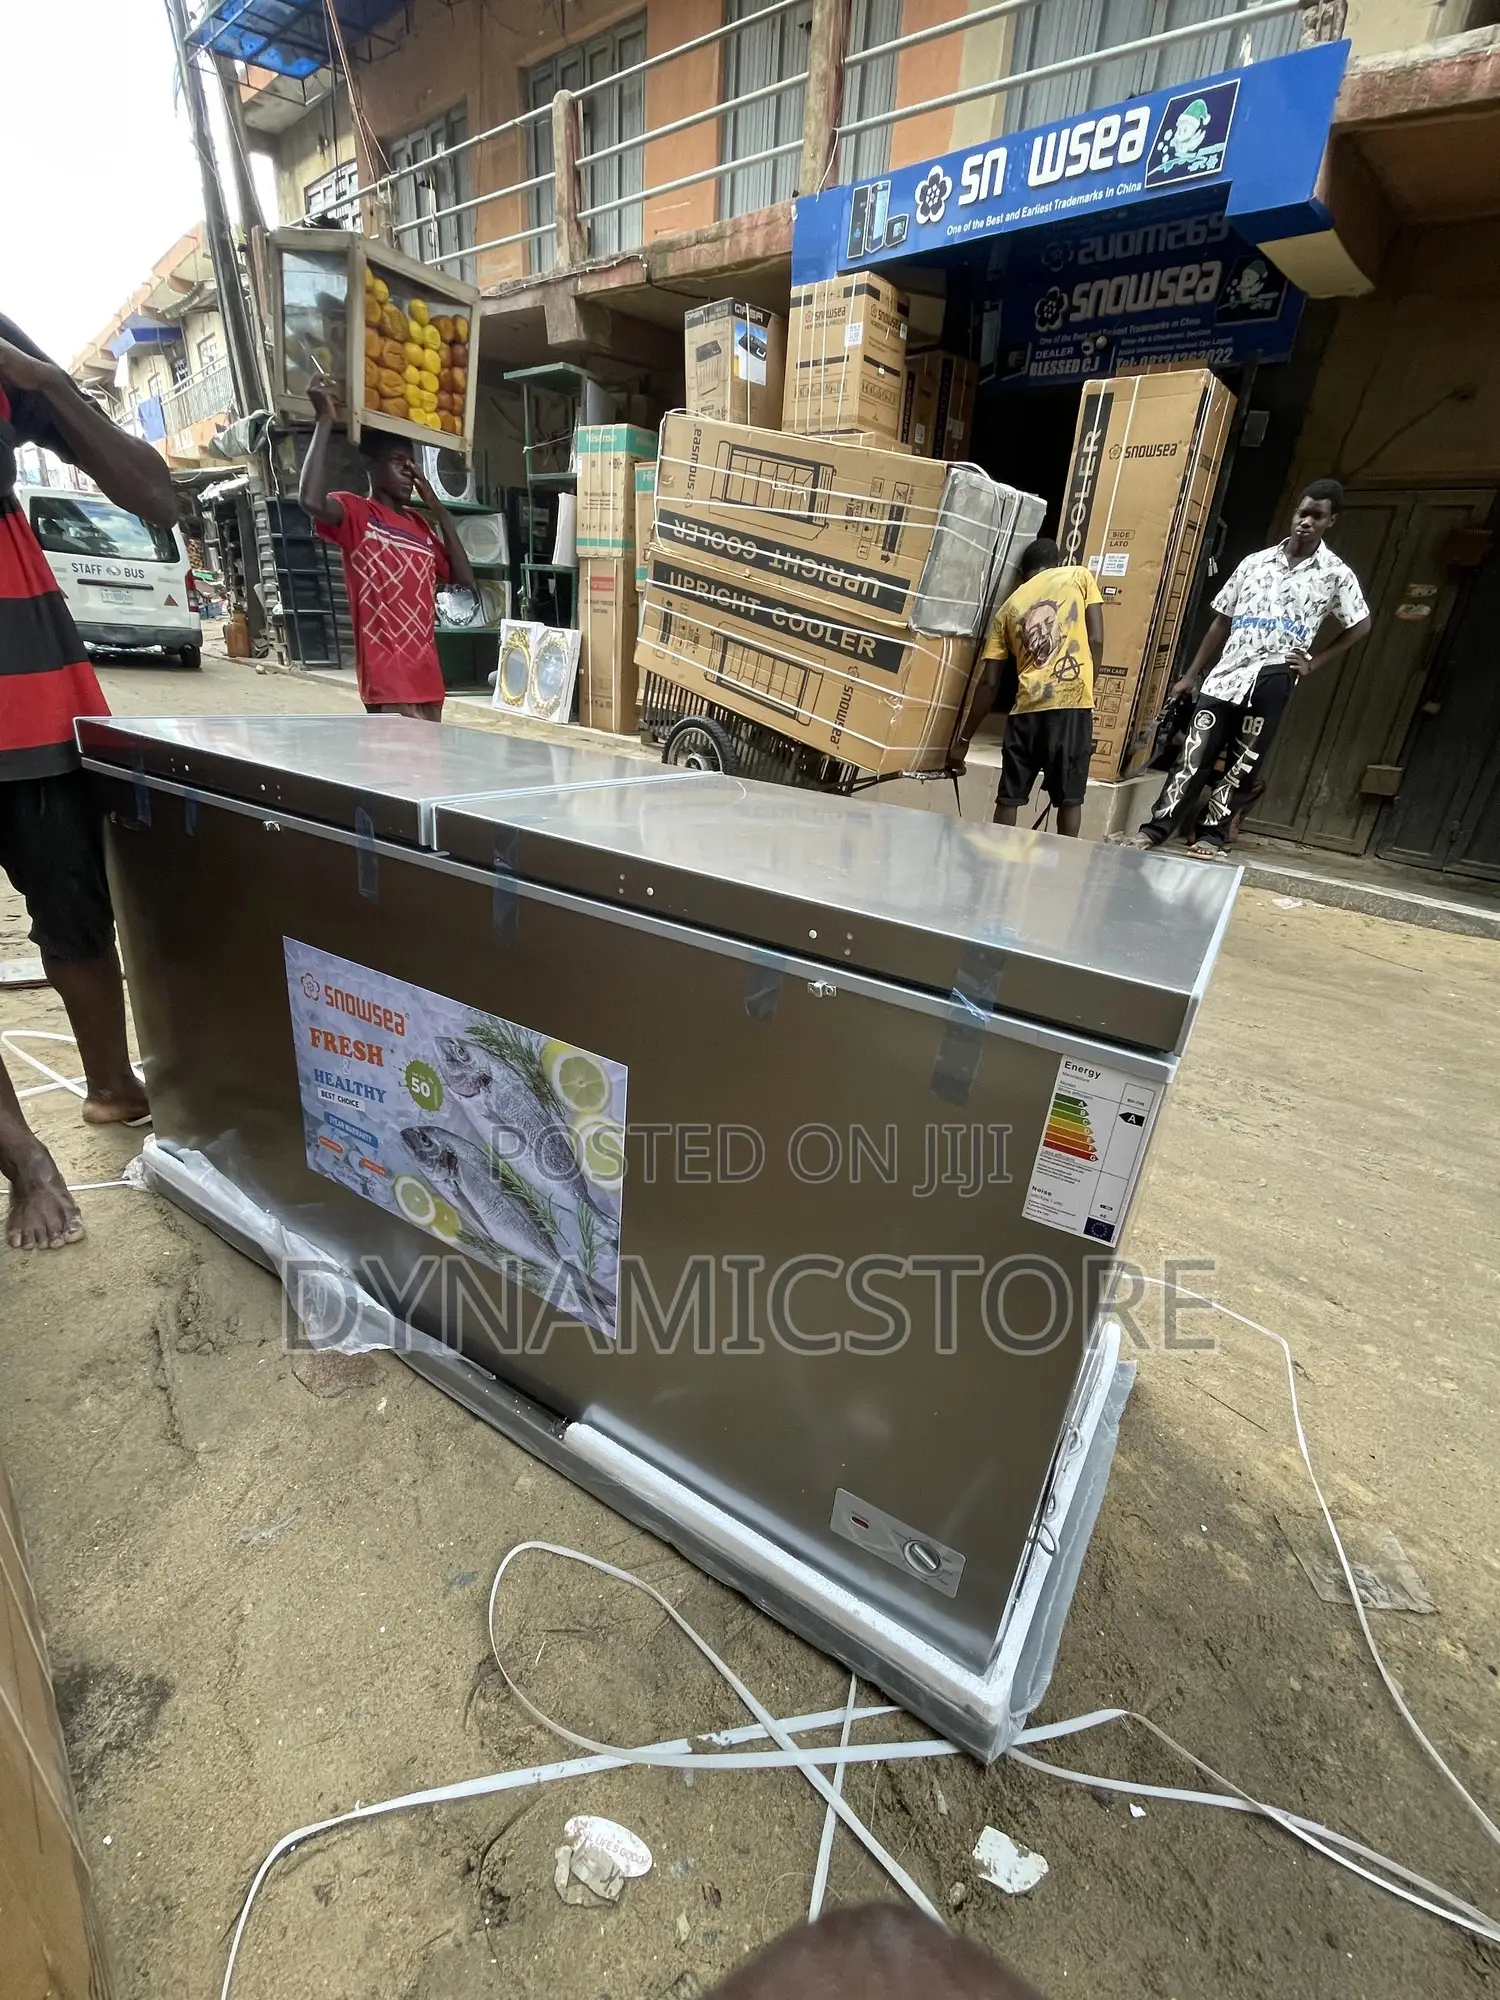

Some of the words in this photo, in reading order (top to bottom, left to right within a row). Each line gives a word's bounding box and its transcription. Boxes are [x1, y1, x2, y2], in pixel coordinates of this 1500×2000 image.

[946, 223, 962, 236] One
[963, 219, 973, 231] of
[972, 217, 985, 230] the
[986, 213, 1004, 227] Best
[1005, 209, 1020, 222] and
[1021, 201, 1053, 218] Earliest
[1054, 190, 1104, 211] Trademarks
[1116, 181, 1142, 196] China
[1035, 346, 1074, 360] DEALER
[1029, 358, 1082, 377] BLESSED
[673, 518, 758, 561] COOLER
[1112, 531, 1131, 539] SIDE
[71, 562, 102, 576] STAFF
[124, 567, 145, 579] BUS
[768, 549, 882, 598] UPRIGHT
[669, 571, 762, 616] UPRIGHT
[771, 606, 877, 659] COOLER
[1241, 716, 1265, 736] 08
[309, 1026, 384, 1068] FRESH
[1064, 1060, 1102, 1080] Energy
[313, 1068, 387, 1103] HEALTHY
[411, 1077, 431, 1098] 50
[320, 1090, 336, 1101] BEST
[337, 1095, 360, 1109] CHOICE
[1128, 1114, 1136, 1124] A
[1031, 1185, 1053, 1197] Noise
